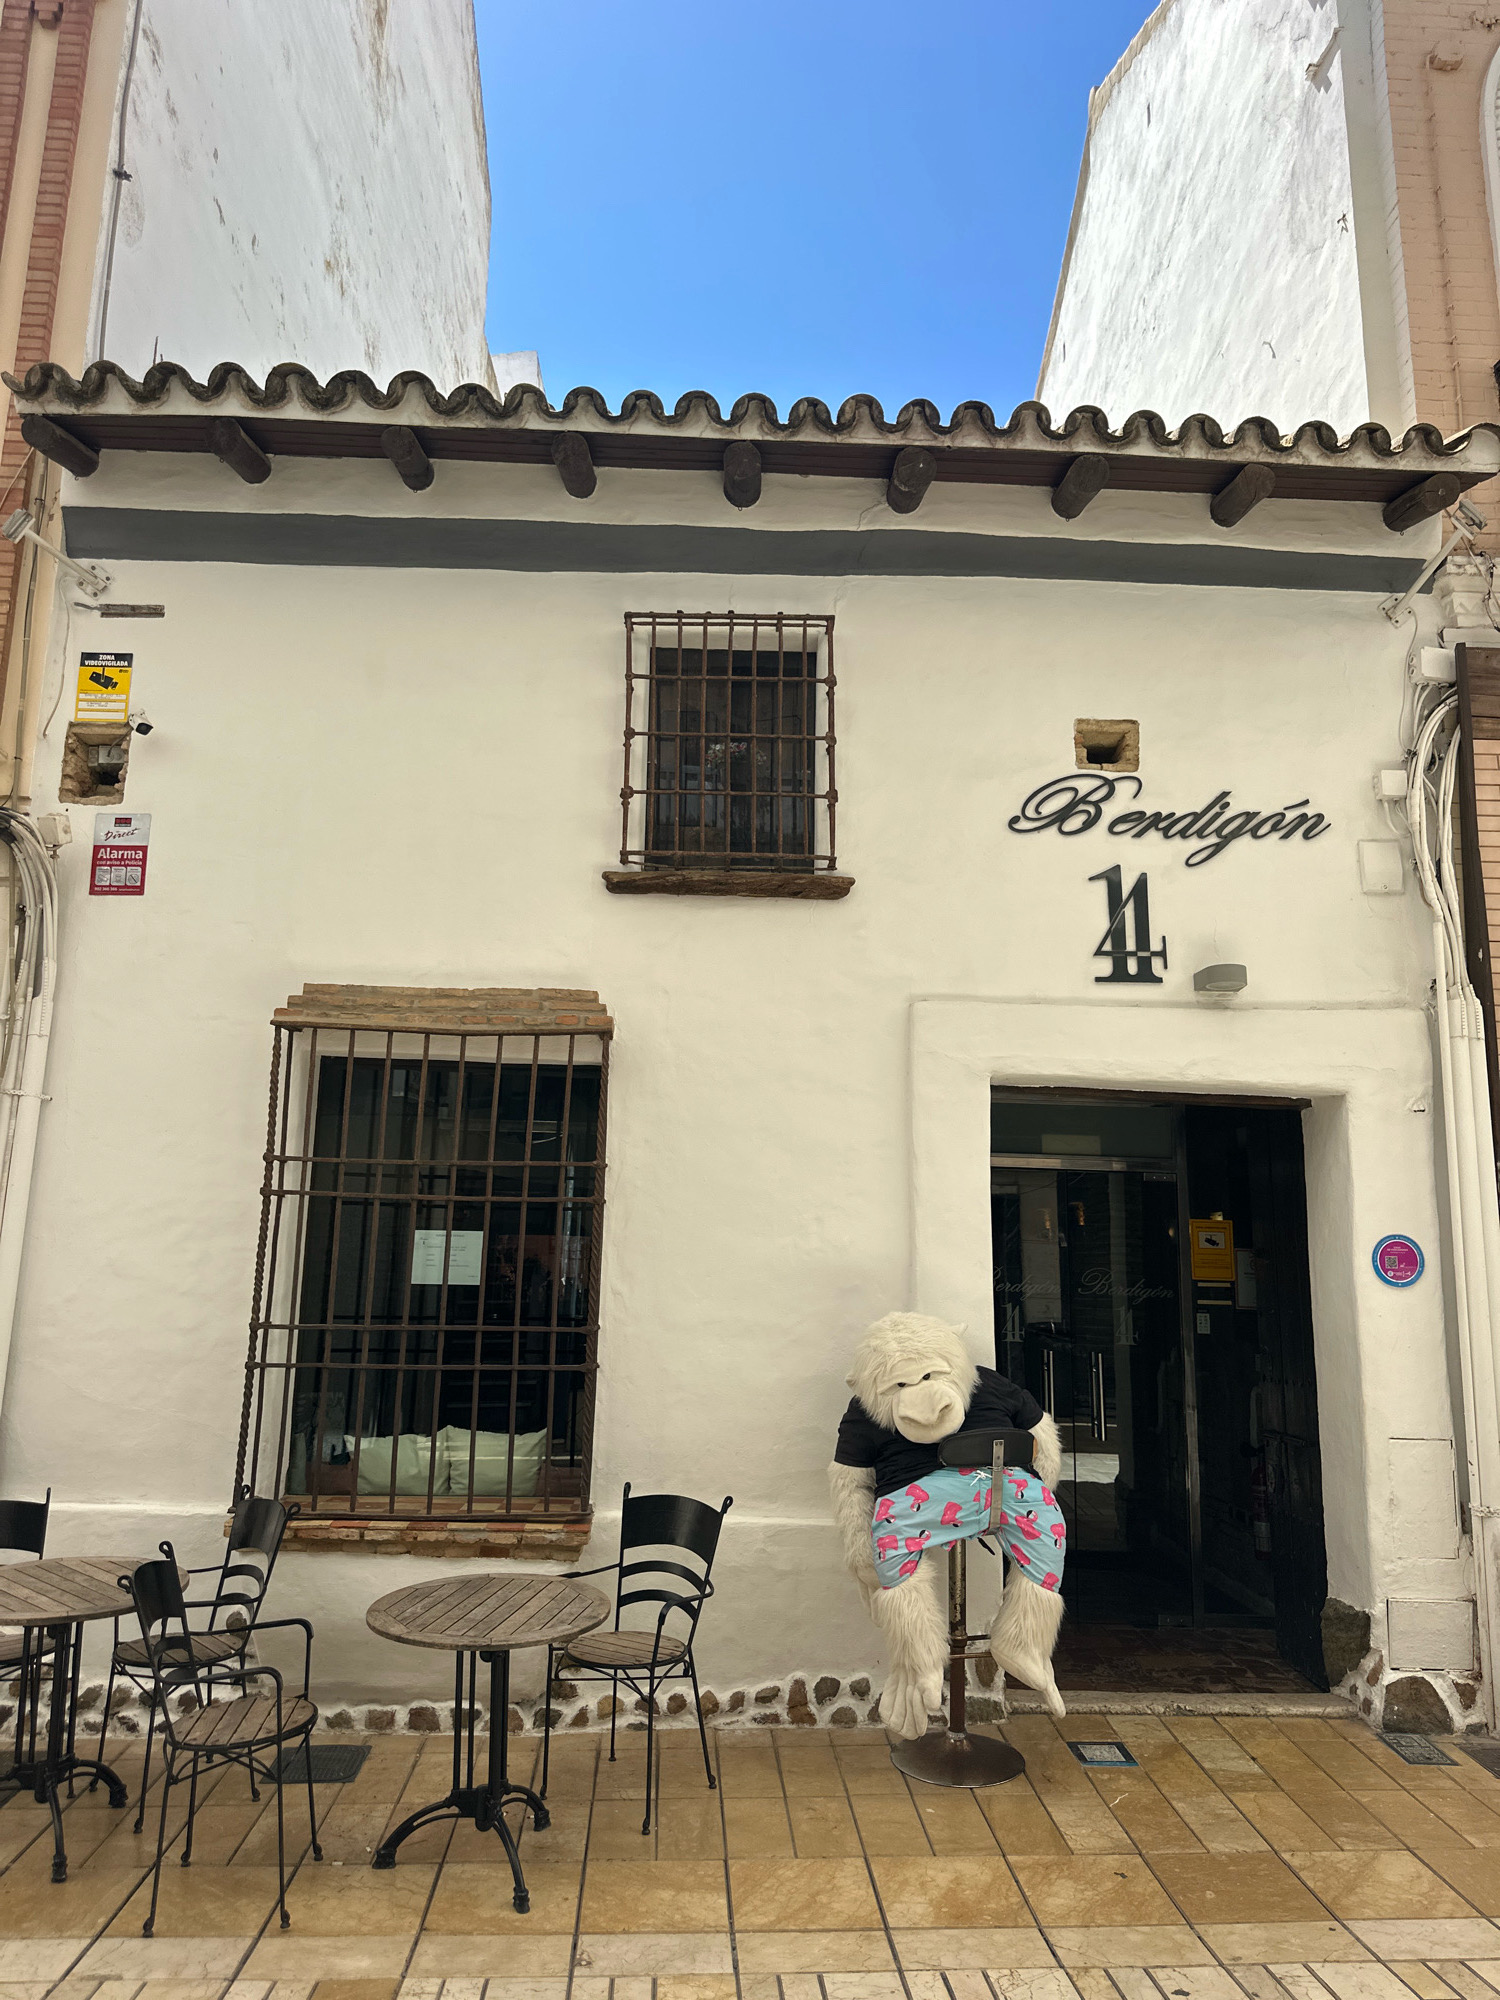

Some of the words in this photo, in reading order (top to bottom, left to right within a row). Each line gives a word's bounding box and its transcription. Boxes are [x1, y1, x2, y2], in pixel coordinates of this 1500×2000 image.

[1007, 773, 1332, 867] Berdigón
[104, 828, 141, 841] Direct
[97, 848, 143, 859] Alarma
[1077, 1267, 1176, 1306] Berdigón
